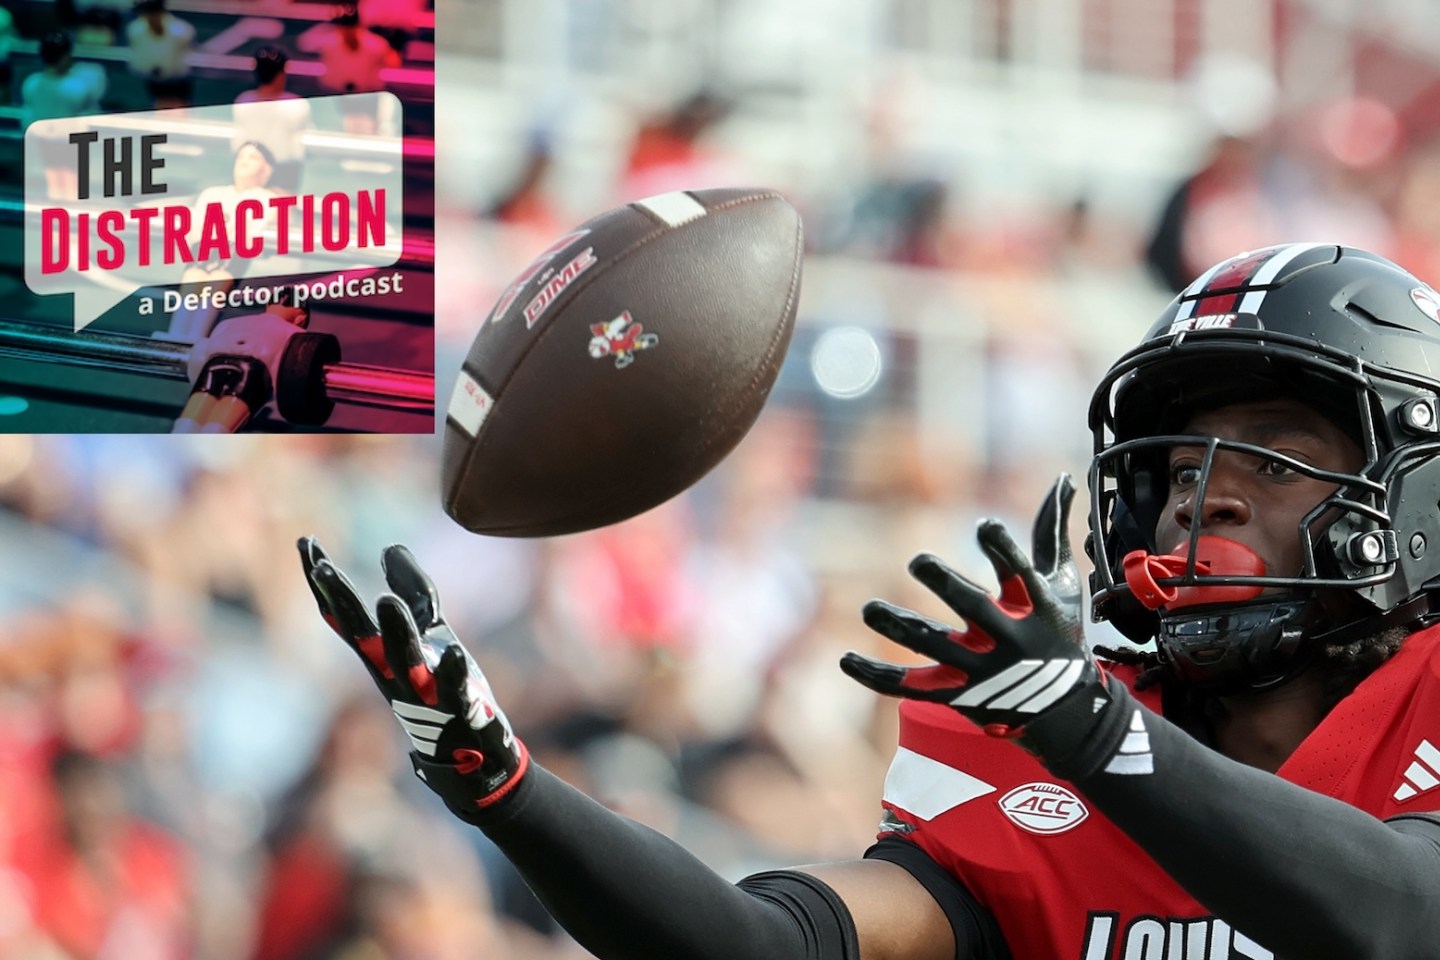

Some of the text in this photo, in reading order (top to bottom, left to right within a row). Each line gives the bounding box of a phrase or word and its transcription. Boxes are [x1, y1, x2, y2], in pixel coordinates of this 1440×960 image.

[522, 246, 598, 330] DIME
[1194, 314, 1238, 330] VILLE
[1013, 795, 1076, 816] ACC
